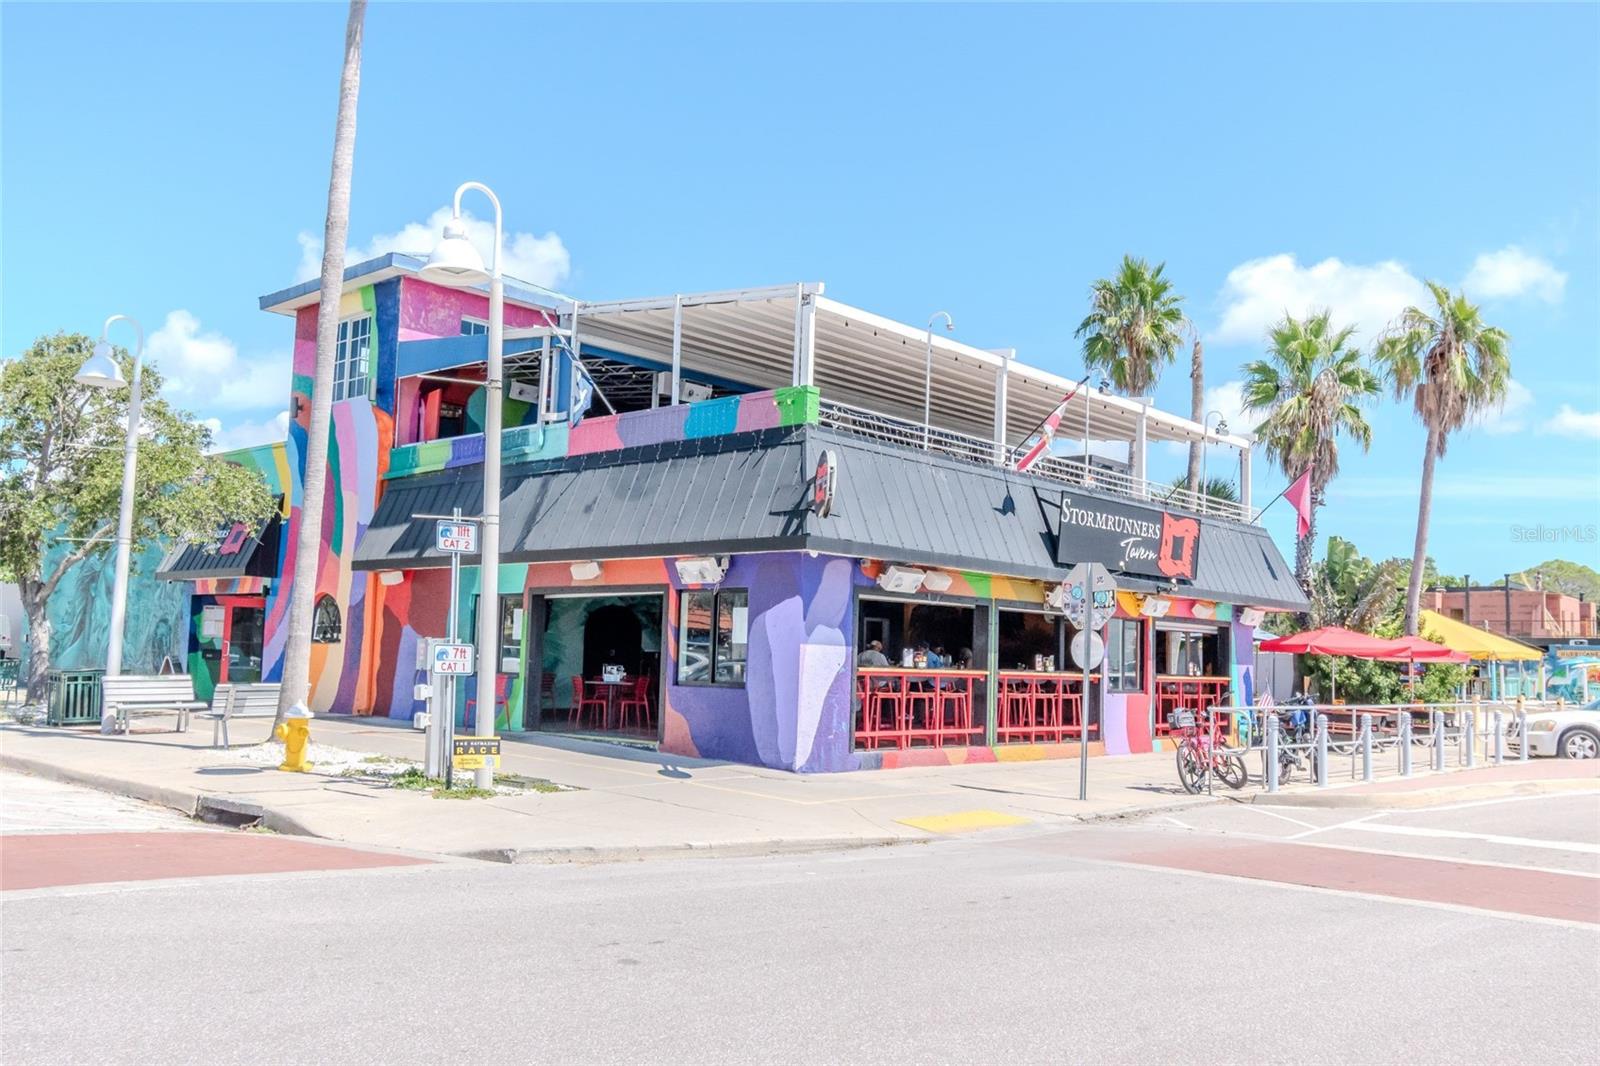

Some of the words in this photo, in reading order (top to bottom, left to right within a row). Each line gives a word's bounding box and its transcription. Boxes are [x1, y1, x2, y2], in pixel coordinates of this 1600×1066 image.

[1061, 498, 1160, 539] STORMRUNNERS
[443, 538, 460, 549] CAT
[464, 540, 471, 550] 2
[1120, 537, 1158, 562] Tavern
[453, 647, 467, 659] 7ft
[440, 662, 458, 672] CAT
[456, 746, 498, 755] RACE
